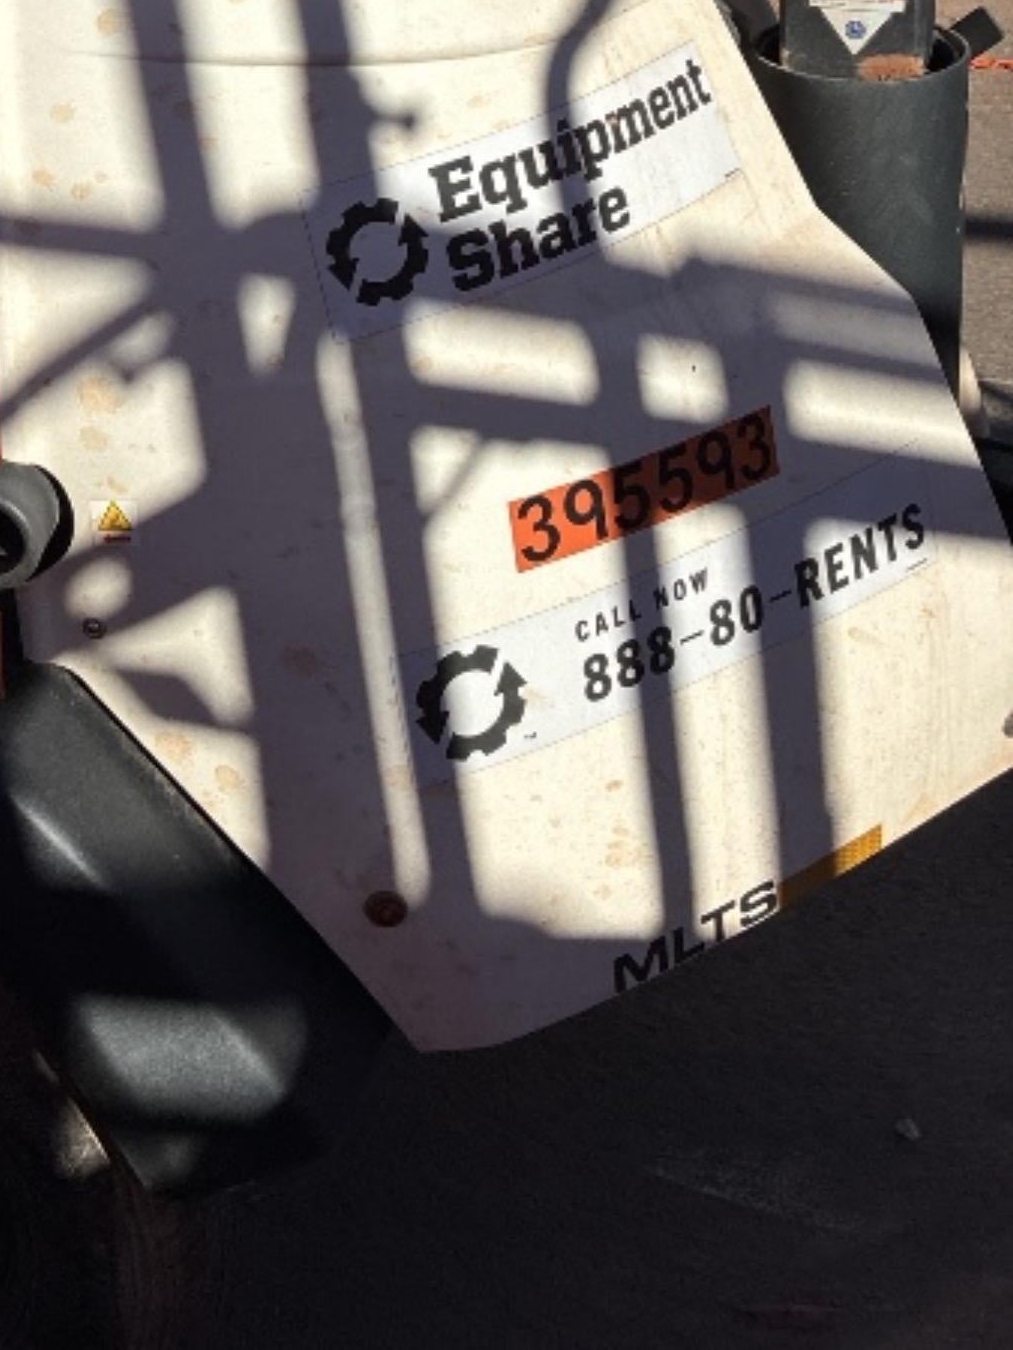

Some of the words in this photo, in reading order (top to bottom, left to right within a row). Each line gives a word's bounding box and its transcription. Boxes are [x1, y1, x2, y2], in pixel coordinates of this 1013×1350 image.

[428, 57, 712, 223] Equipment
[446, 186, 631, 292] Share
[517, 412, 773, 564] 395593
[575, 599, 643, 642] CALL
[652, 567, 709, 611] NOW
[583, 502, 926, 703] 888-80-RENTS
[613, 879, 779, 994] MLTS
